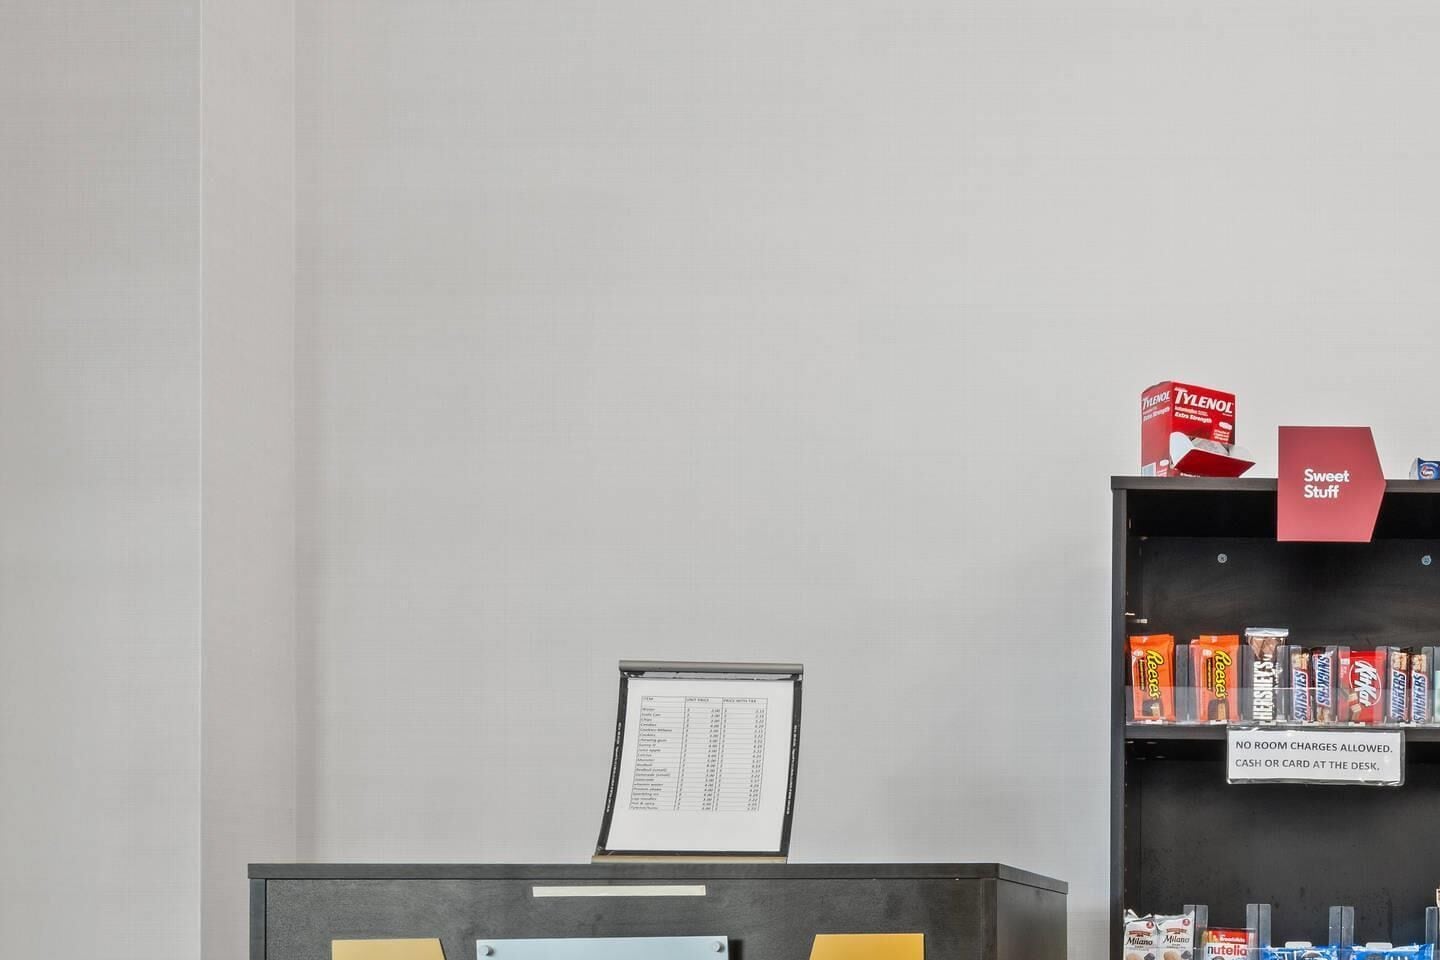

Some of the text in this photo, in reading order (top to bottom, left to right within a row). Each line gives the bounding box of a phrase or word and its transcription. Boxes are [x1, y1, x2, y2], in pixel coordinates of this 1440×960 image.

[1142, 391, 1170, 410] TYLENOL
[1174, 389, 1233, 414] TYLENOL
[1174, 411, 1213, 424] Extra Strength
[1304, 468, 1350, 482] Sweet
[1304, 484, 1340, 498] Stuff
[1146, 649, 1165, 700] Reese's
[1214, 649, 1233, 699] Reese's
[1391, 671, 1407, 721] SNICKERS
[1412, 675, 1427, 724] SNICKERS
[1235, 740, 1393, 753] NO ROOM CHARGES ALLOWED.
[1235, 759, 1380, 770] CASH OR CARD AT THE DESK.
[1126, 936, 1153, 946] Milano
[1163, 934, 1190, 944] Milano
[1207, 944, 1248, 956] nutella
